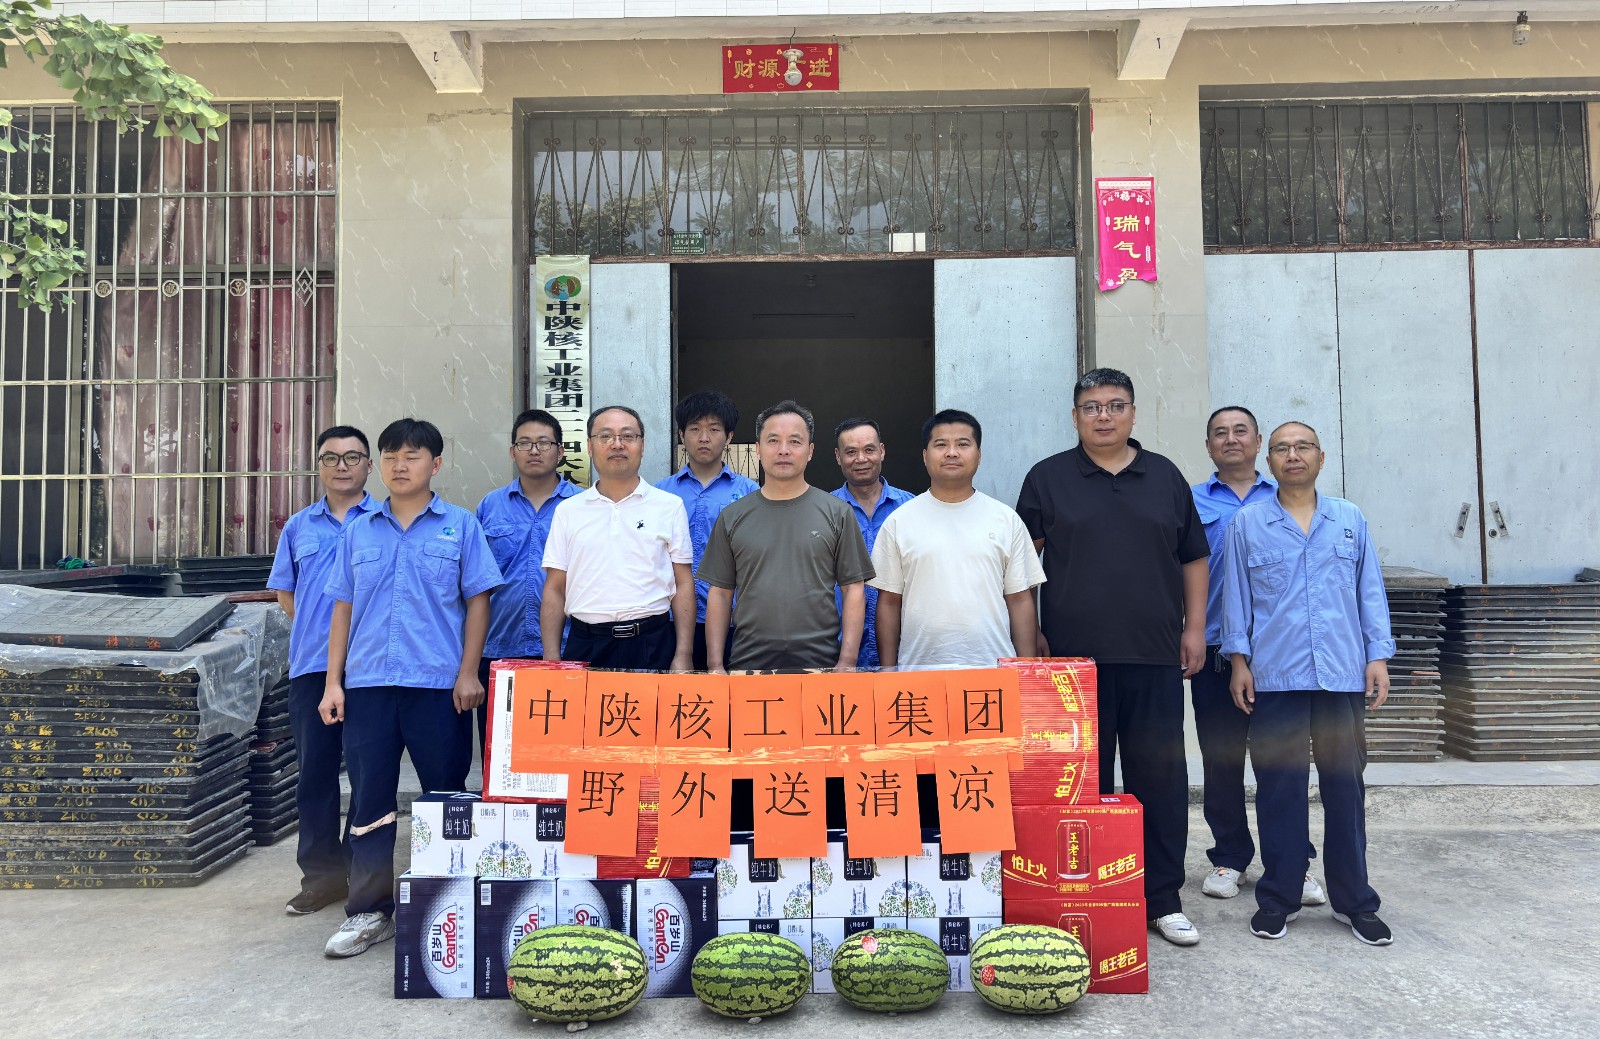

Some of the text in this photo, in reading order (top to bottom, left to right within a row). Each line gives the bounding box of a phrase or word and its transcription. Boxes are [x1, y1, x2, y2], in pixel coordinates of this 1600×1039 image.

[733, 58, 832, 79] 财源进
[529, 688, 1004, 740] 中陕核工业集团
[578, 764, 995, 818] 野外送清凉
[1053, 761, 1080, 798] 怕上火
[445, 818, 470, 836] 纯牛奶
[538, 820, 564, 837] 纯牛奶
[1068, 832, 1080, 870] 王老吉
[751, 860, 776, 878] 纯牛奶
[846, 859, 872, 876] 纯牛奶
[942, 859, 969, 876] 纯牛奶
[1011, 853, 1048, 881] 怕上火
[1097, 853, 1137, 881] 喝王老吉
[431, 924, 442, 962] 百岁山
[670, 914, 680, 952] 百岁山
[942, 933, 968, 950] 纯牛奶
[1099, 947, 1138, 975] 喝王老吉
